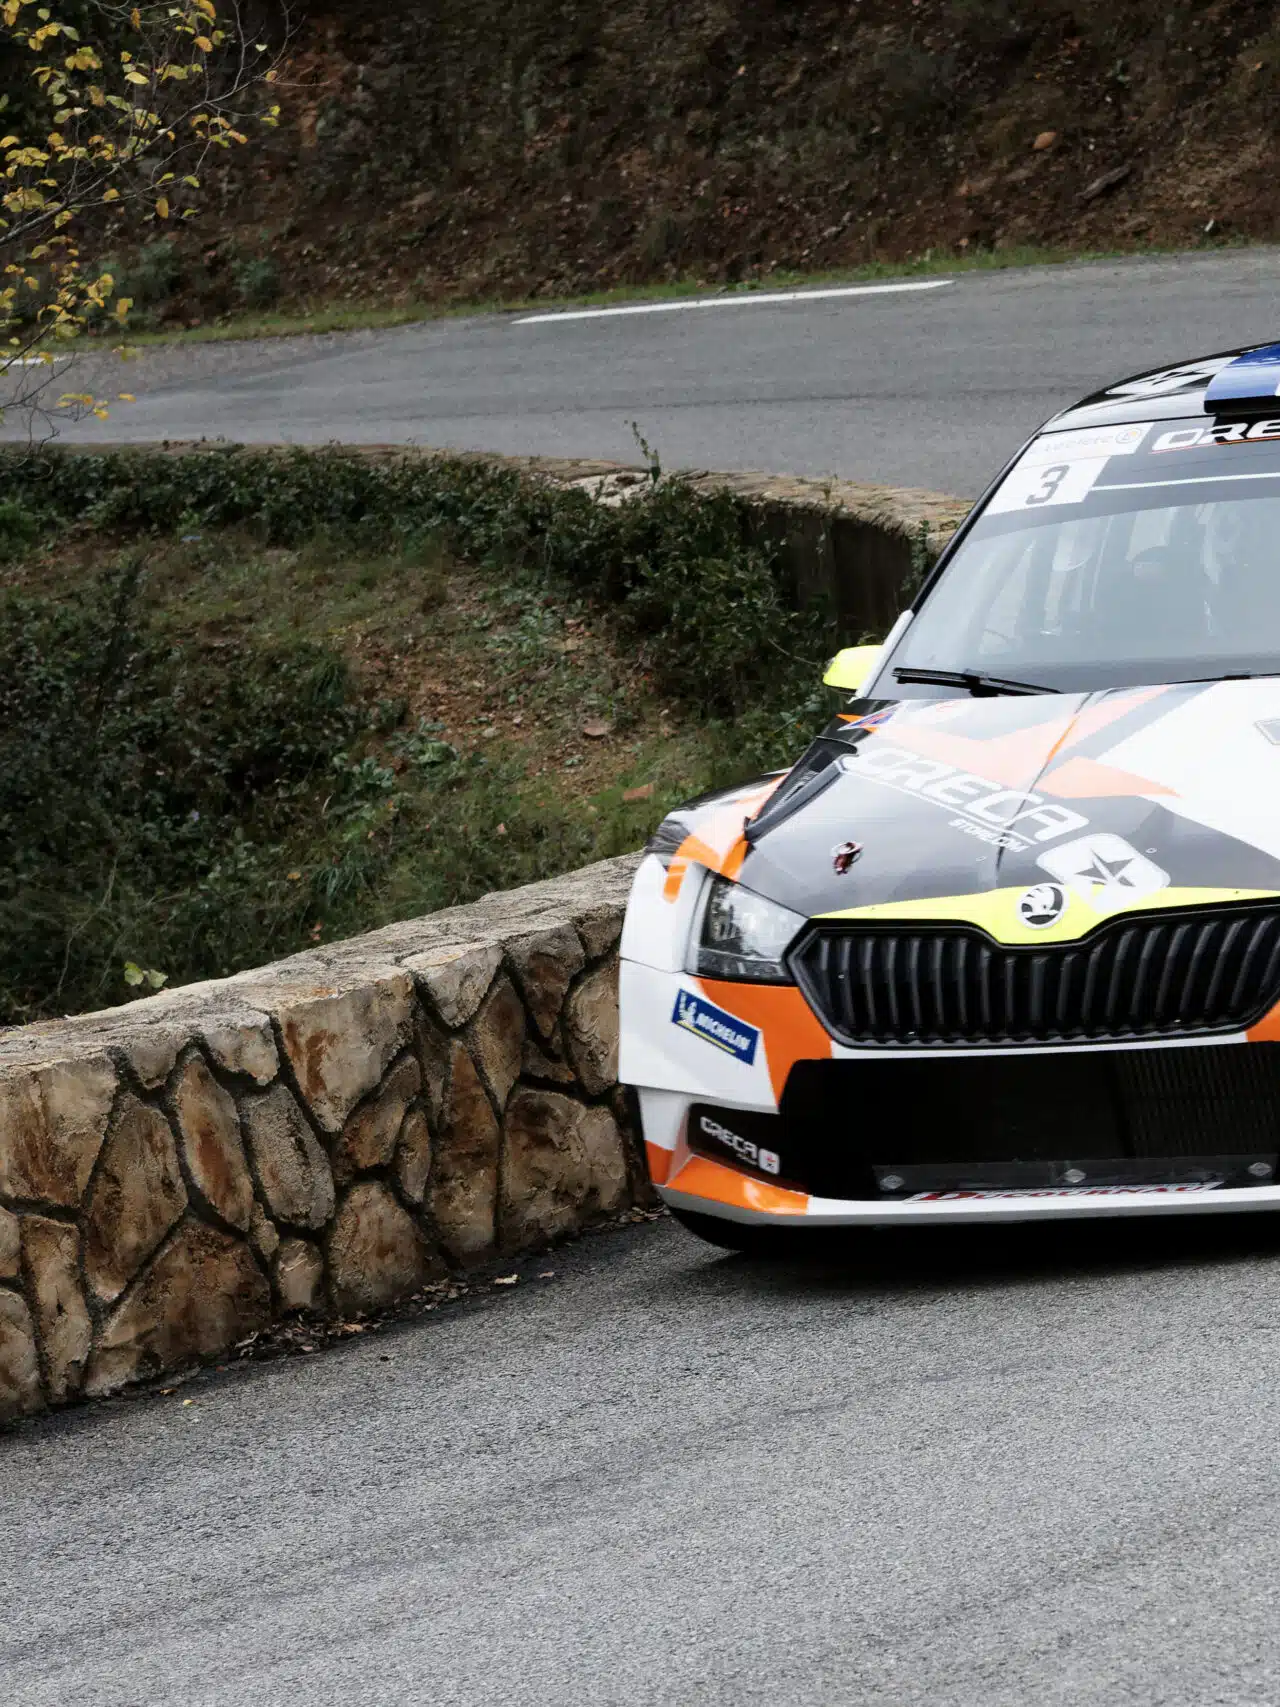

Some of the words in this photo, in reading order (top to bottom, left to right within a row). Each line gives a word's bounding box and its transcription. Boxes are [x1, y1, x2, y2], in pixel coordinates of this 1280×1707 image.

[1026, 464, 1070, 504] 3
[843, 748, 1090, 842] ORECA
[695, 1012, 751, 1051] MICHELIN
[700, 1116, 758, 1160] ORECA
